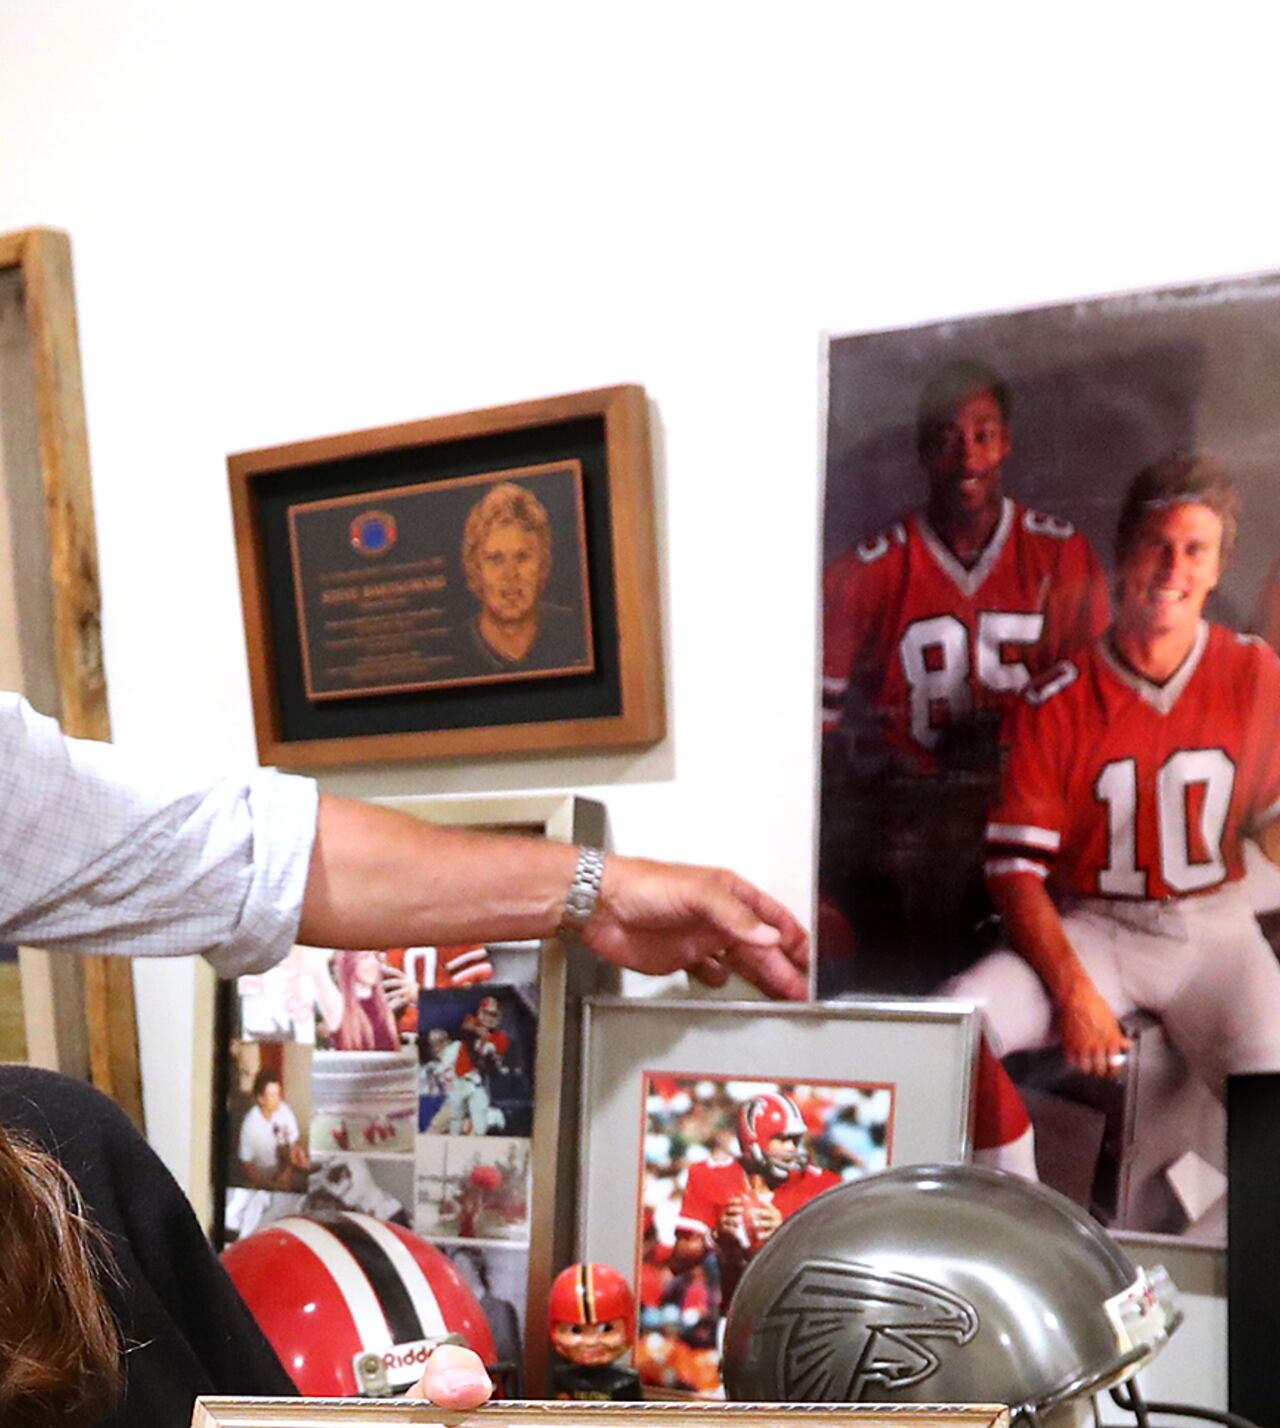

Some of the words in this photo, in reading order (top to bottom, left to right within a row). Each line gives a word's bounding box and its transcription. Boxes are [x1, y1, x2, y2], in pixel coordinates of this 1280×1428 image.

[900, 610, 1044, 749] 85
[1093, 746, 1237, 897] 10
[383, 1345, 434, 1371] Ridd
